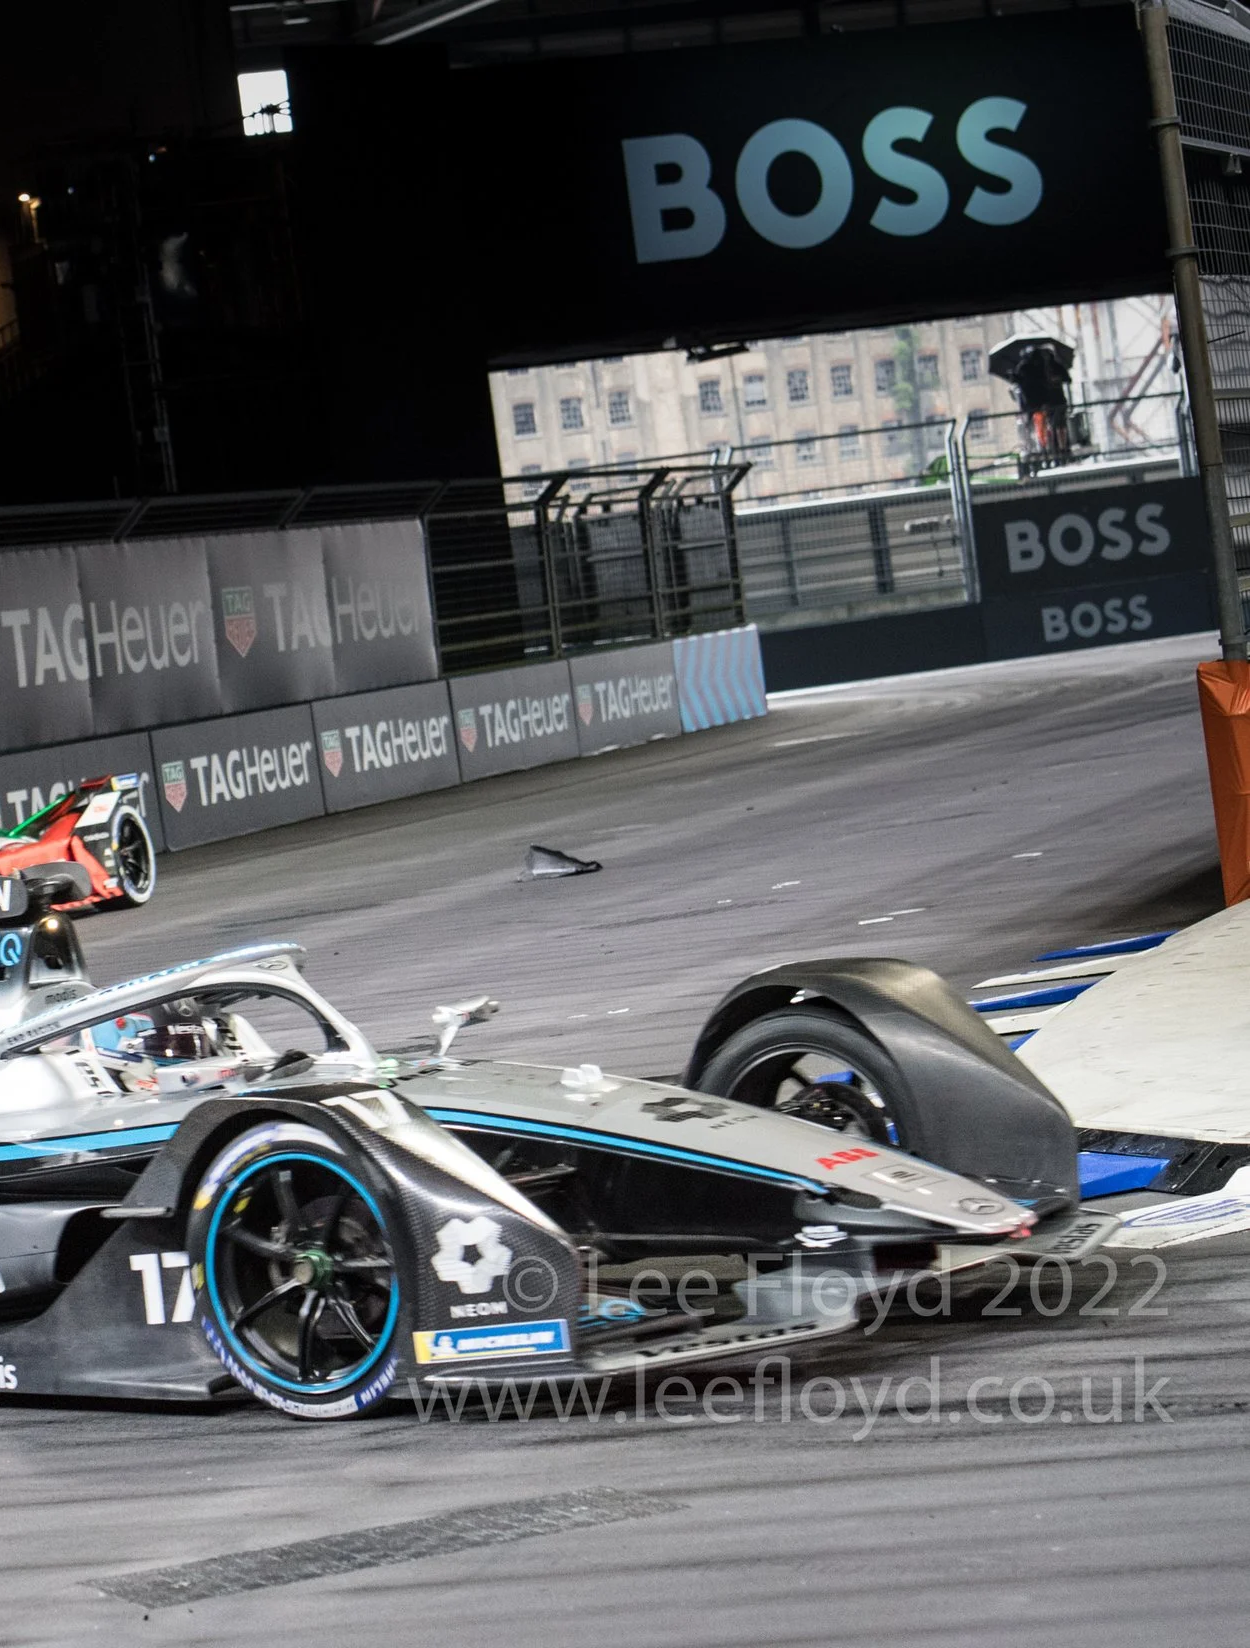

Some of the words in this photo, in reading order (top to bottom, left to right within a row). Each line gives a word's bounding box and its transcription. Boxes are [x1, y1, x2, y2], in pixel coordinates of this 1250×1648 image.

[622, 95, 1043, 264] BOSS
[1004, 502, 1171, 573] BOSS
[1, 600, 205, 688] TAGHeuer
[1041, 594, 1153, 642] BOSS
[190, 741, 312, 806] TAGHeuer
[345, 713, 448, 773] TAGHeuer
[815, 1147, 880, 1170] ABB
[129, 1250, 195, 1325] 17
[450, 1301, 508, 1319] NEOM
[456, 1330, 555, 1351] MICHELIN
